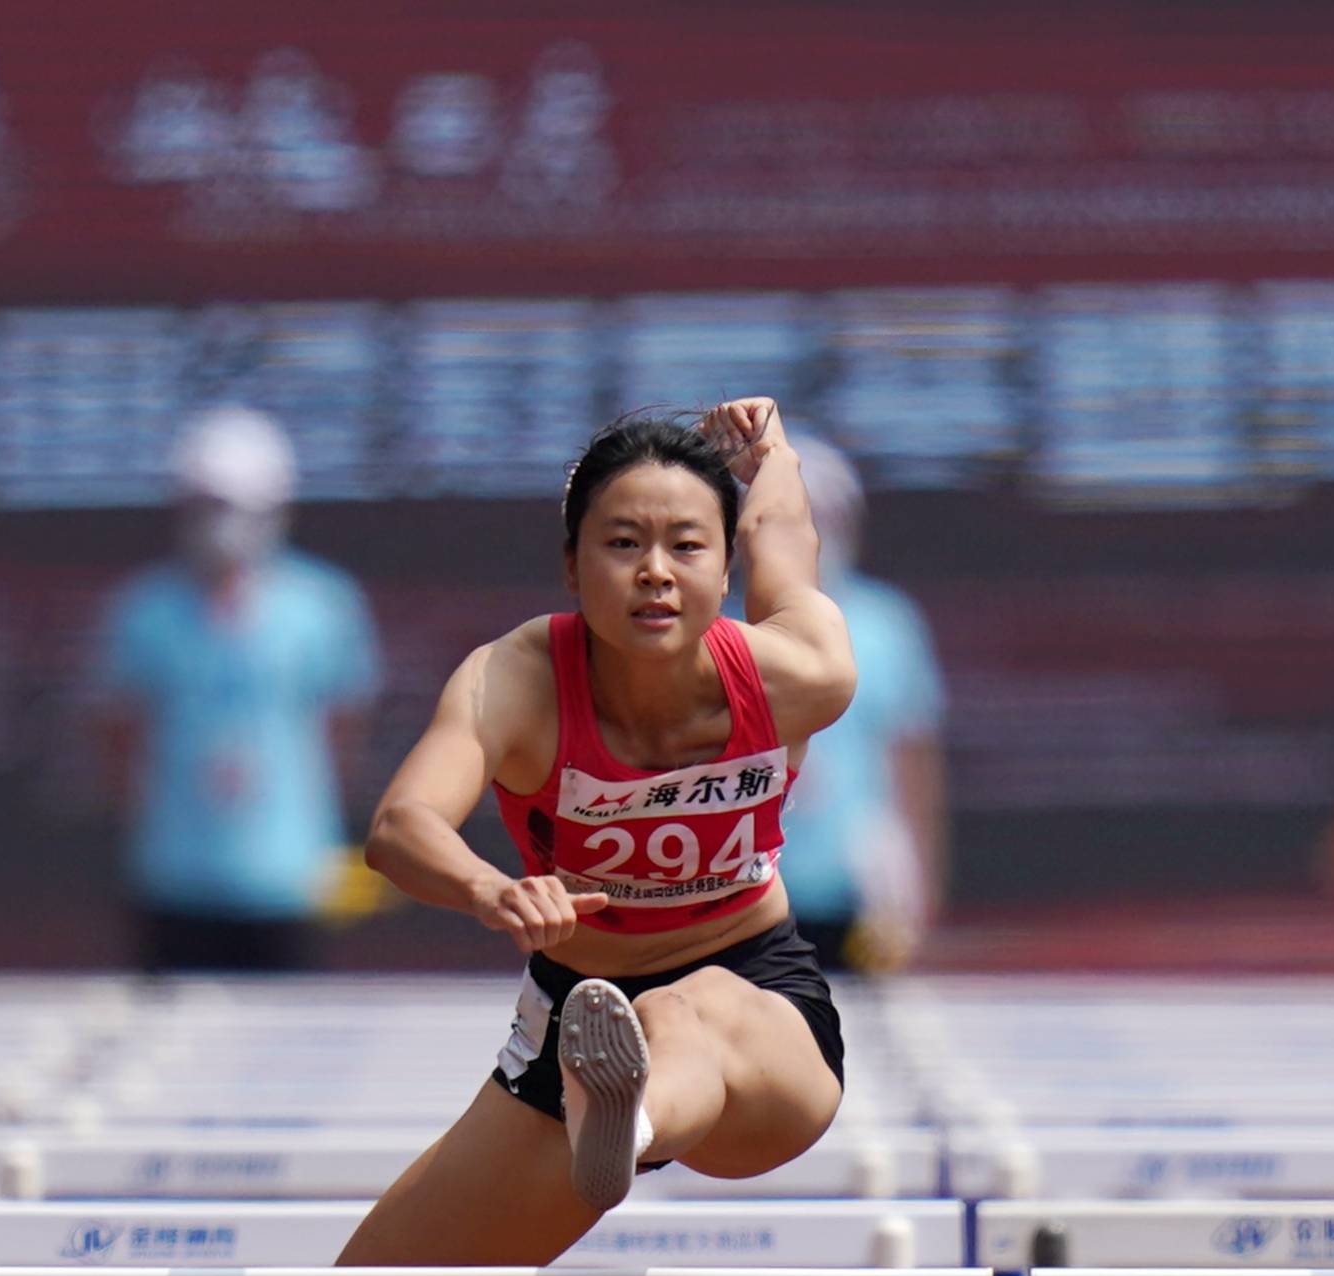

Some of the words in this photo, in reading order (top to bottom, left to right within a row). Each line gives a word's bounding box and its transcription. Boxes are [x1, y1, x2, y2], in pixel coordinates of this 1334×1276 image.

[643, 765, 775, 808] 海尔斯
[581, 812, 756, 881] 294
